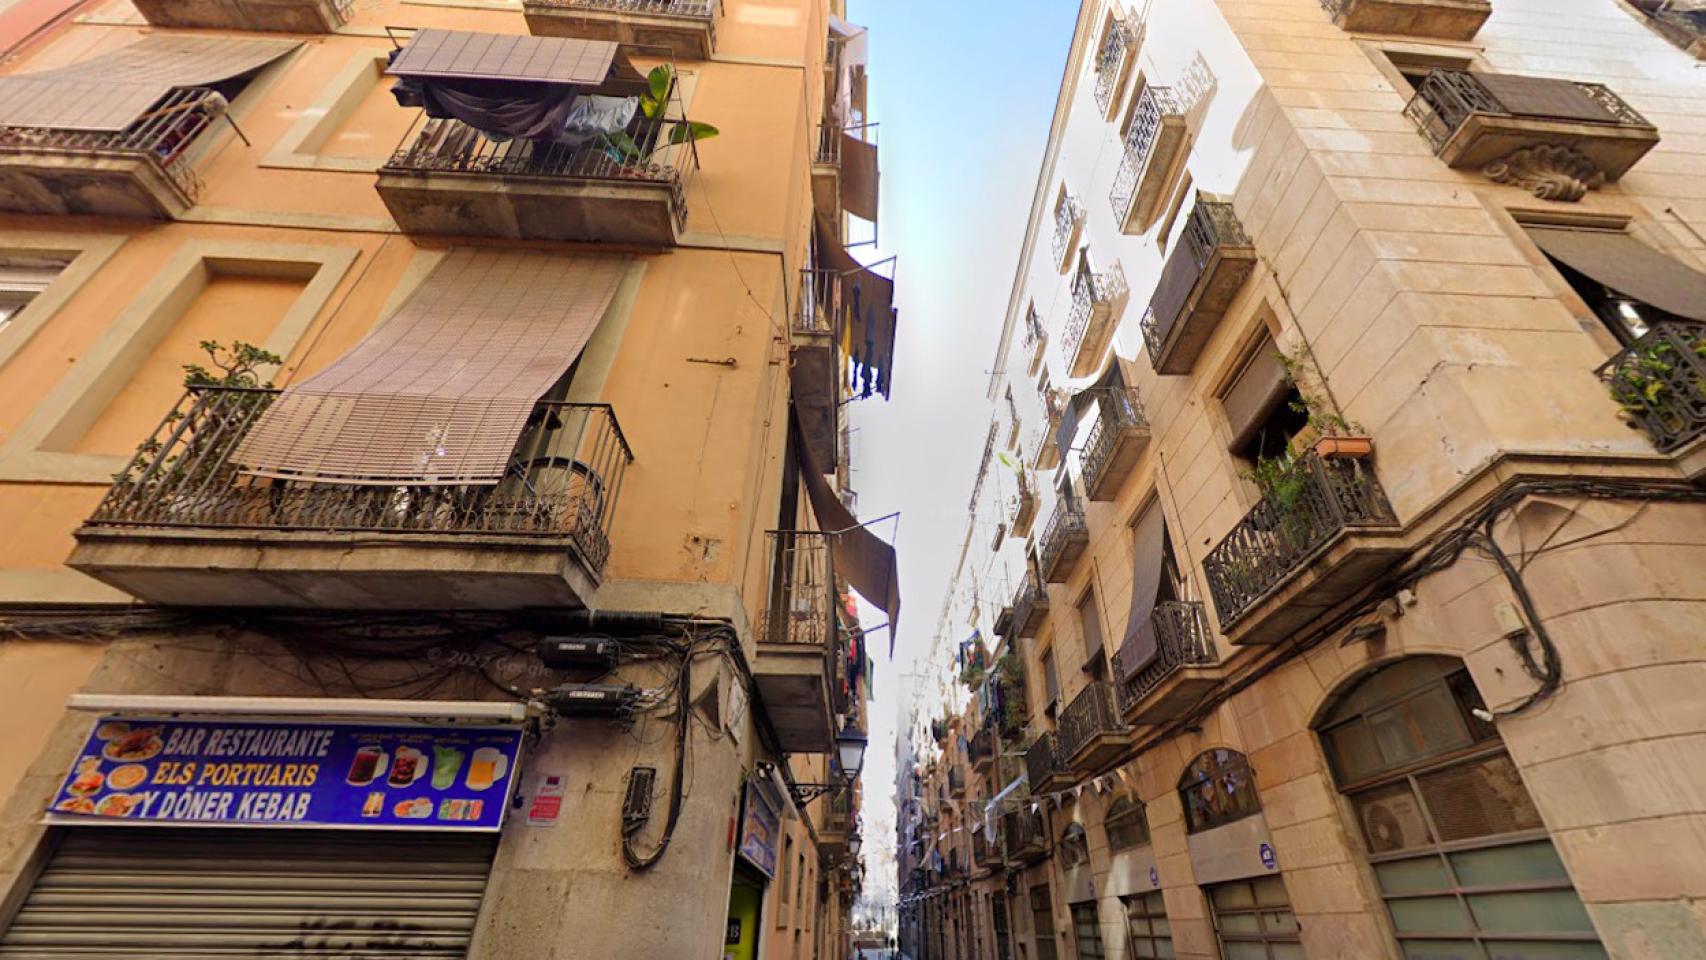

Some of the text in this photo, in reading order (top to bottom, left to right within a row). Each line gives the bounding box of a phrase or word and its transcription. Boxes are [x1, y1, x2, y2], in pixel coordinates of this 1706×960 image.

[163, 728, 334, 757] BAR RESTAURANTE
[151, 762, 320, 787] ELS PORTUARIS
[139, 791, 160, 818] Y
[235, 792, 312, 820] KEBAB
